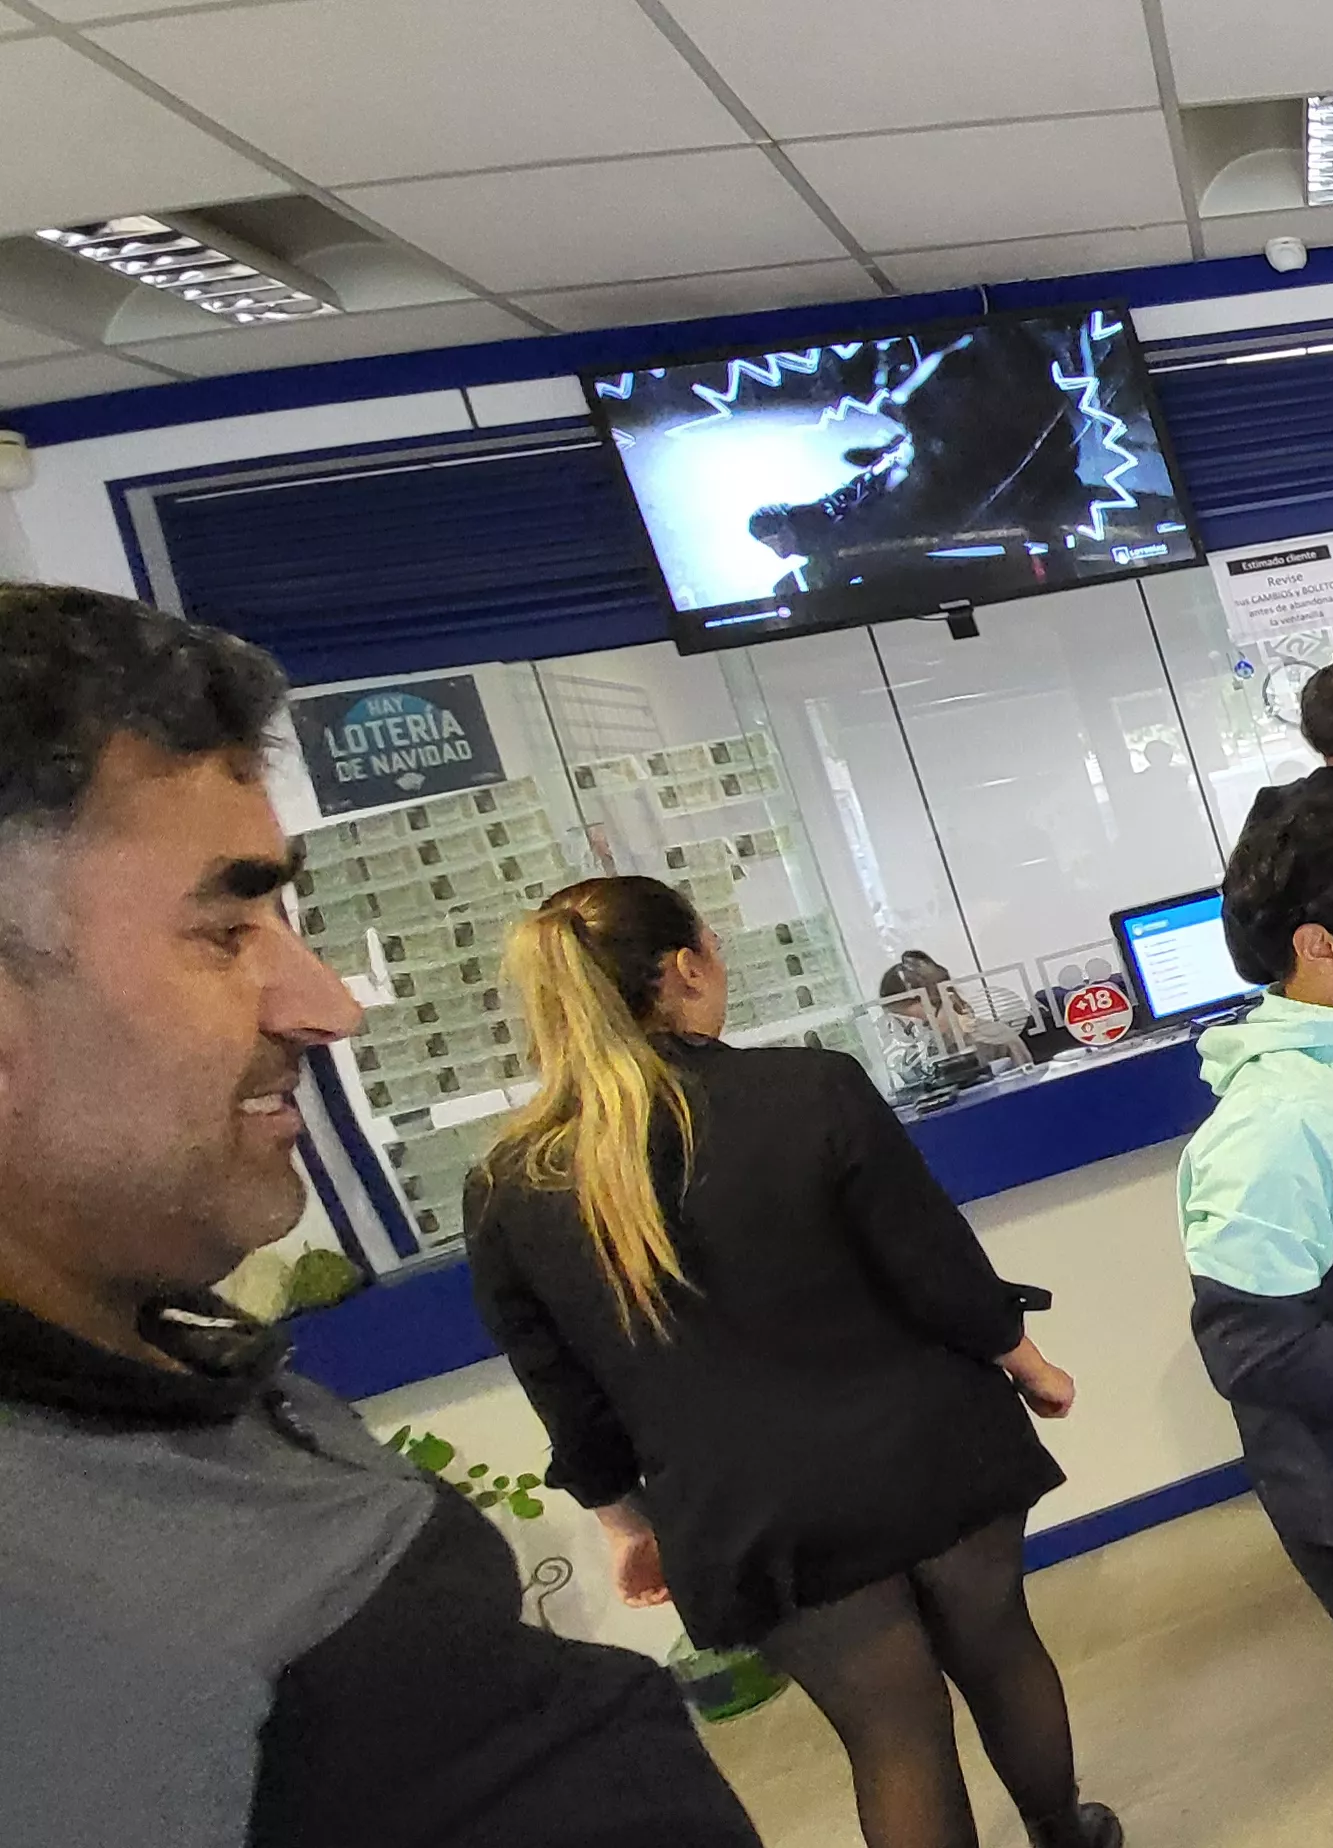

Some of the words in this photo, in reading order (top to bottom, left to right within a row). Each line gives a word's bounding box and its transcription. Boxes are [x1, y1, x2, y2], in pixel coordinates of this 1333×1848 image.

[1241, 556, 1285, 571] Estimado
[1286, 550, 1317, 563] cliente
[1267, 572, 1303, 587] Revise
[1251, 588, 1294, 605] CAMBIOS
[1249, 607, 1275, 618] antes
[1276, 603, 1287, 613] de
[1270, 617, 1279, 627] la
[366, 696, 405, 716] HAY
[324, 703, 466, 758] LOTERÍA
[335, 759, 369, 782] DE
[370, 740, 473, 776] NAVIDAD
[1076, 990, 1113, 1012] +18
